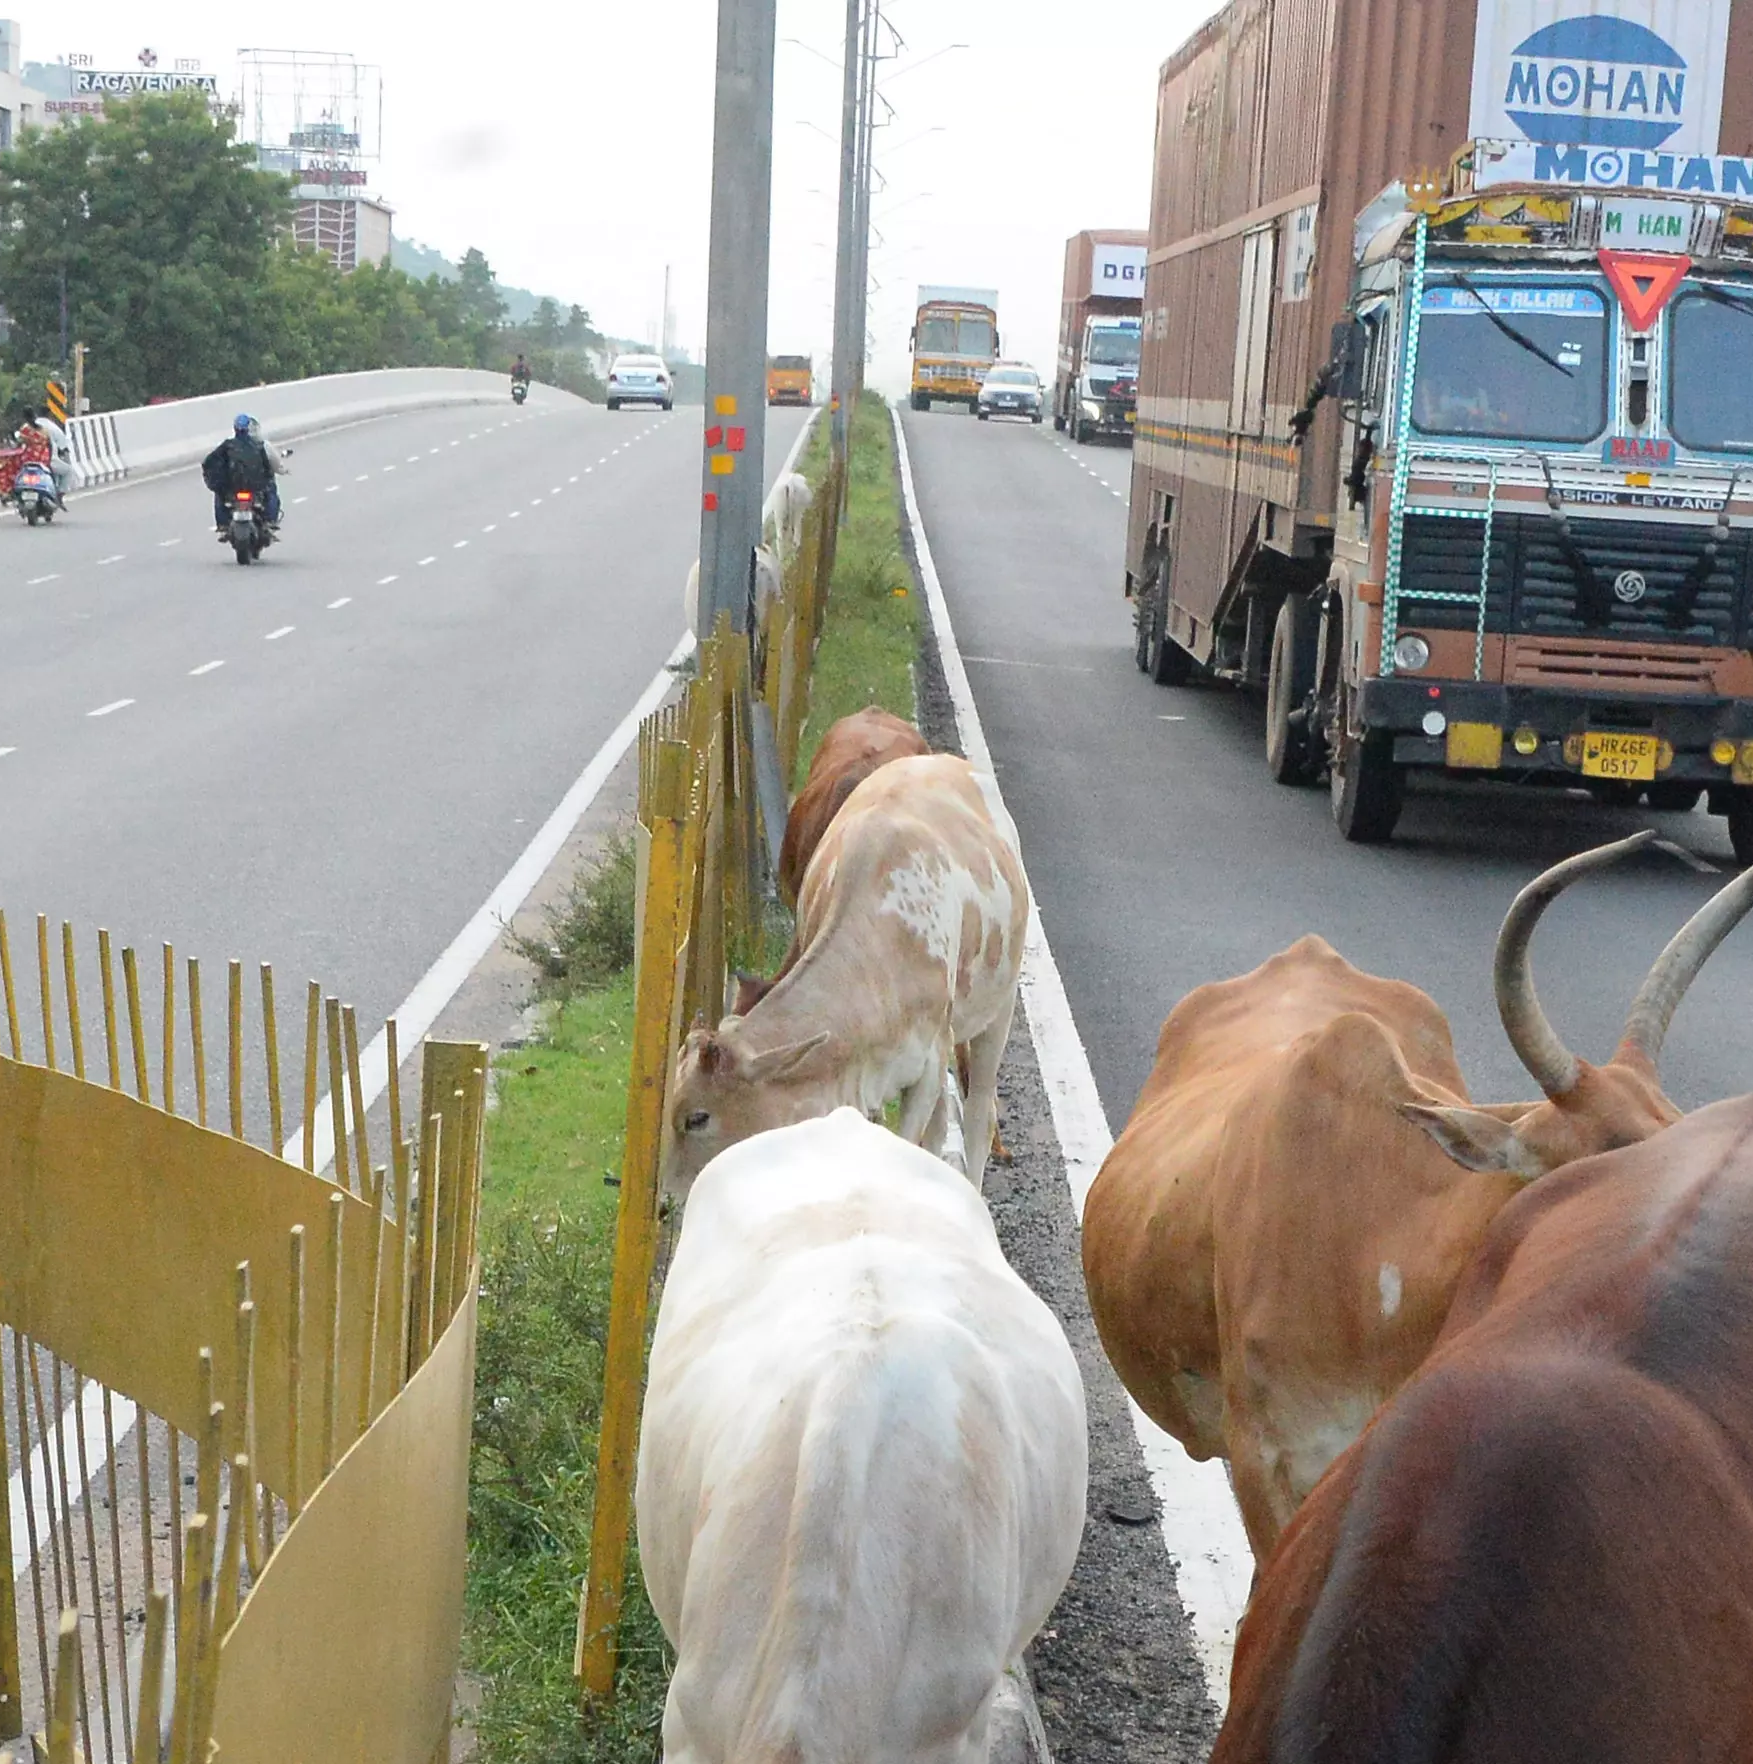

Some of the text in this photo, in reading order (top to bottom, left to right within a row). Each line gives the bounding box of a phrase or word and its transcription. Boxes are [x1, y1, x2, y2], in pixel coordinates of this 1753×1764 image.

[68, 53, 93, 67] SRI
[1505, 61, 1686, 115] MOHAN
[1631, 494, 1726, 511] LEYLAND
[1600, 758, 1639, 776] 0517
